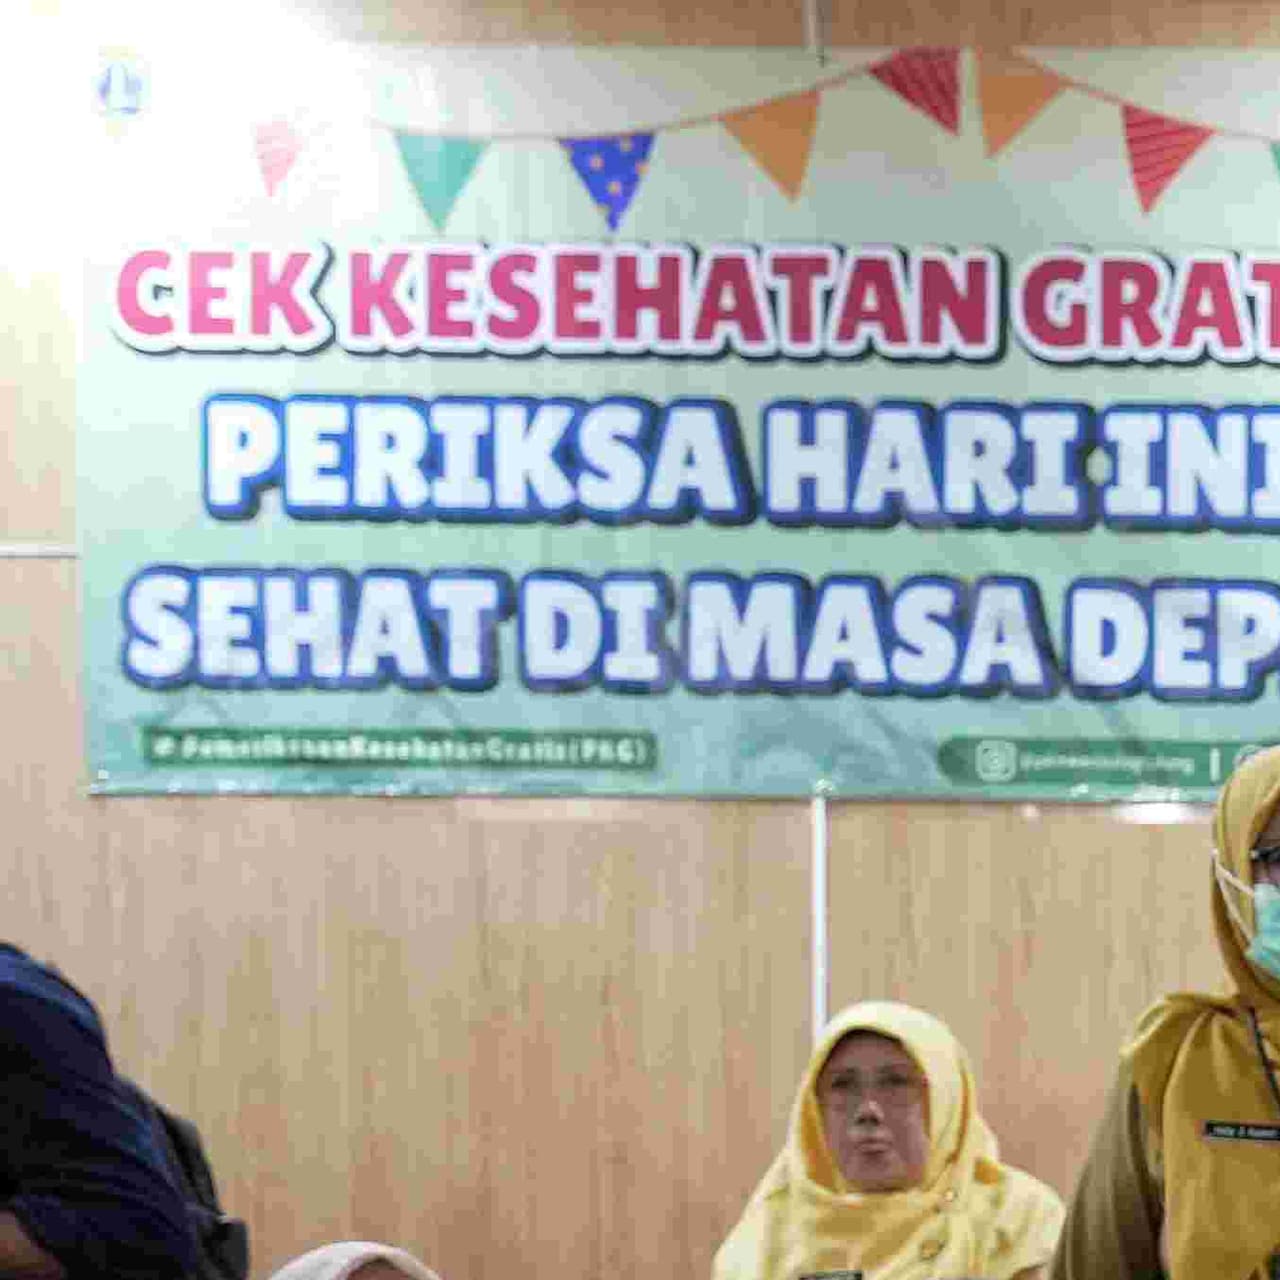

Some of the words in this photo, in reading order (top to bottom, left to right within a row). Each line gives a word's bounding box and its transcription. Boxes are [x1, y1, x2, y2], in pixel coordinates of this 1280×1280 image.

[115, 248, 318, 338] CEK
[348, 250, 1000, 347] KESEHATAN
[203, 399, 742, 513] PERIKSA
[763, 404, 1084, 518] HARI
[125, 569, 502, 684] SEHAT
[520, 572, 664, 687] DI
[685, 573, 1047, 692] MASA
